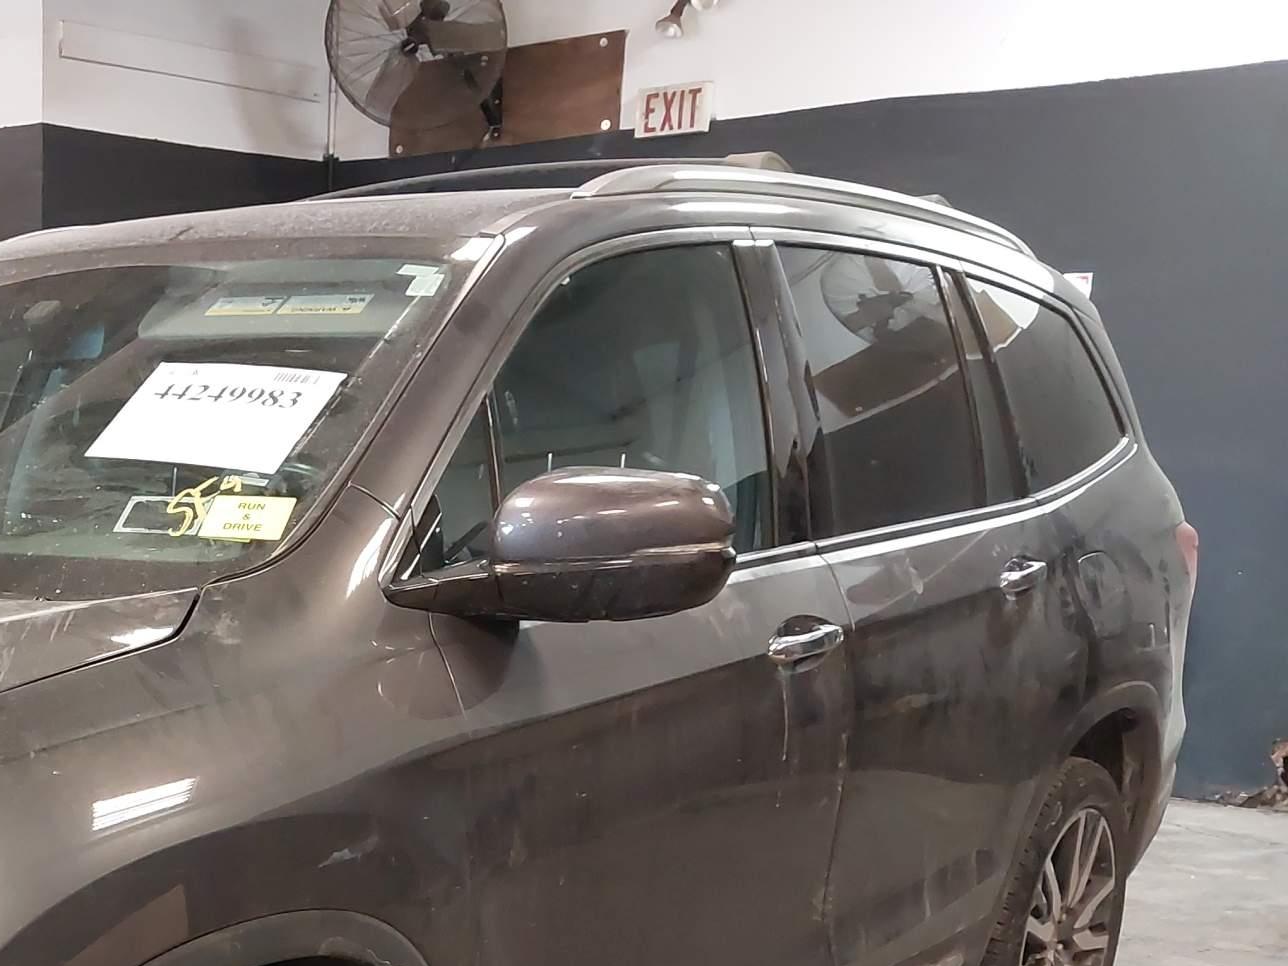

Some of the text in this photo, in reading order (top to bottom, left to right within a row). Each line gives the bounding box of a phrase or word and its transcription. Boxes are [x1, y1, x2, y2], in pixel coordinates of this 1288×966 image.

[643, 87, 702, 133] EXIT
[154, 383, 303, 408] 44249983
[238, 502, 266, 511] RUN
[223, 522, 262, 532] DRIVE
